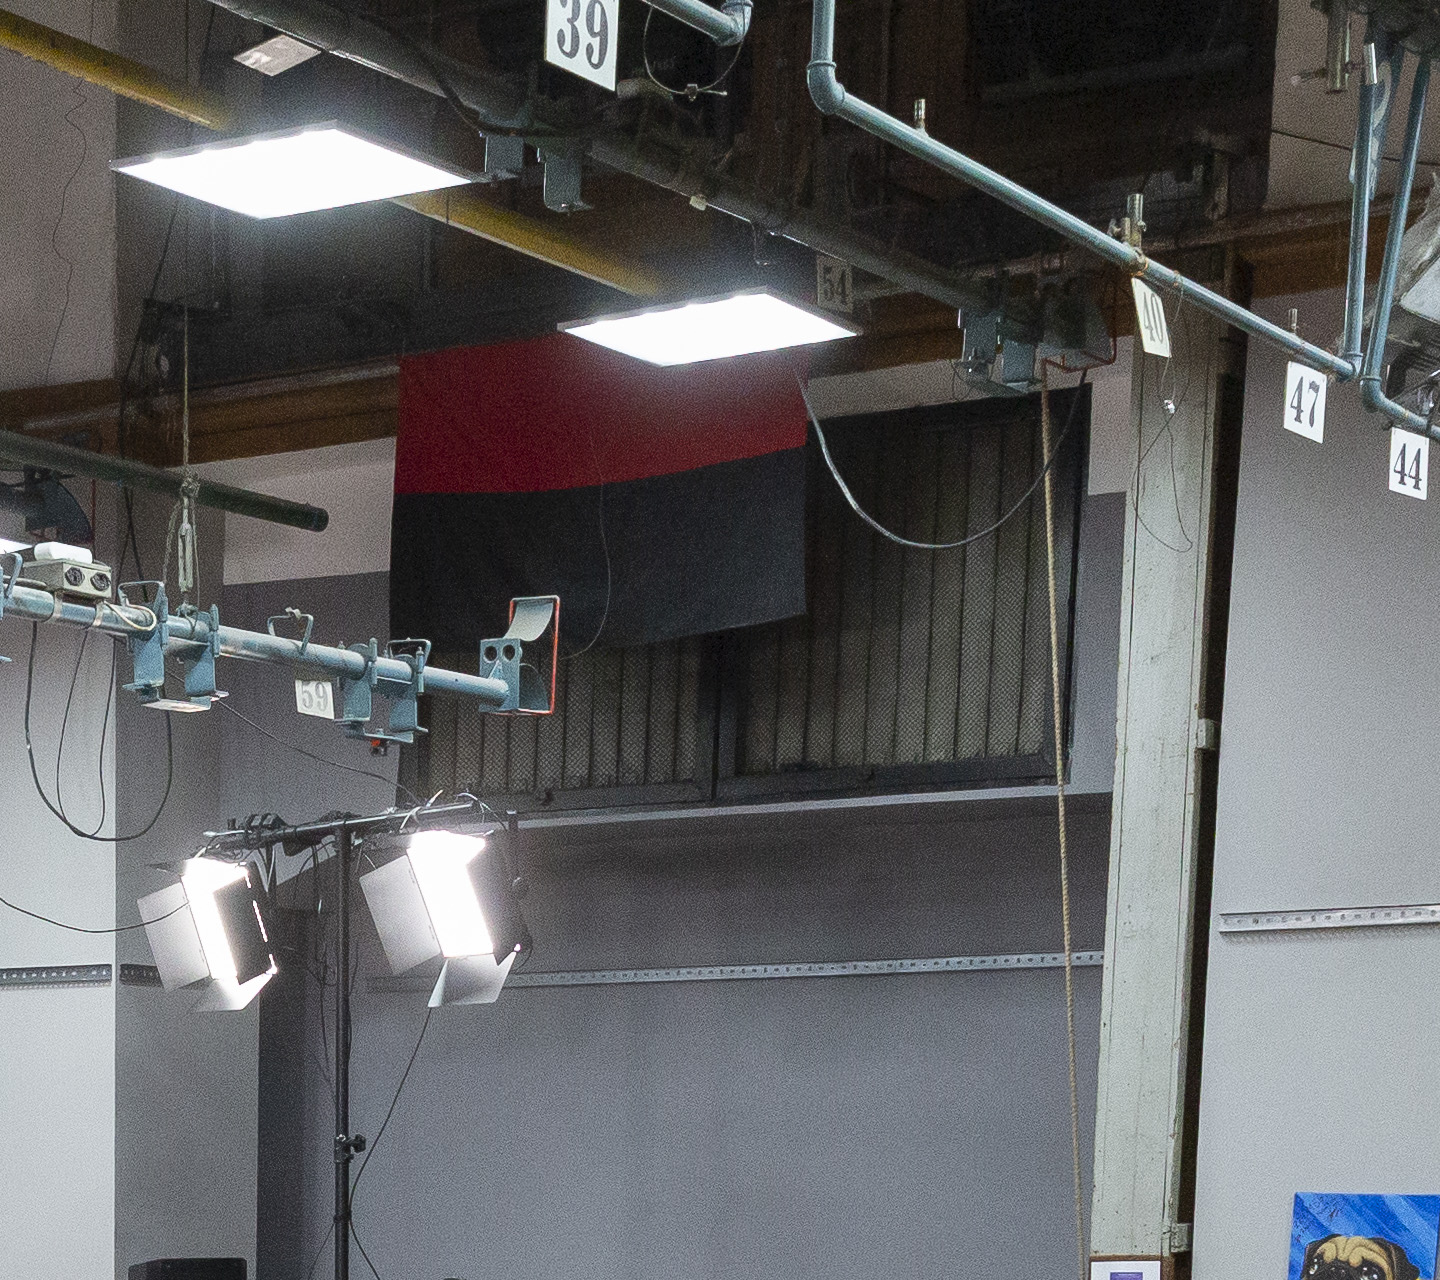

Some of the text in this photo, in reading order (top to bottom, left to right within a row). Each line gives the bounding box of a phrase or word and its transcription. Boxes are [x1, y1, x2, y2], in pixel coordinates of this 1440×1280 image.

[557, 0, 608, 70] 39
[1143, 291, 1163, 345] 40
[1290, 376, 1320, 428] 47
[1393, 443, 1422, 491] 44
